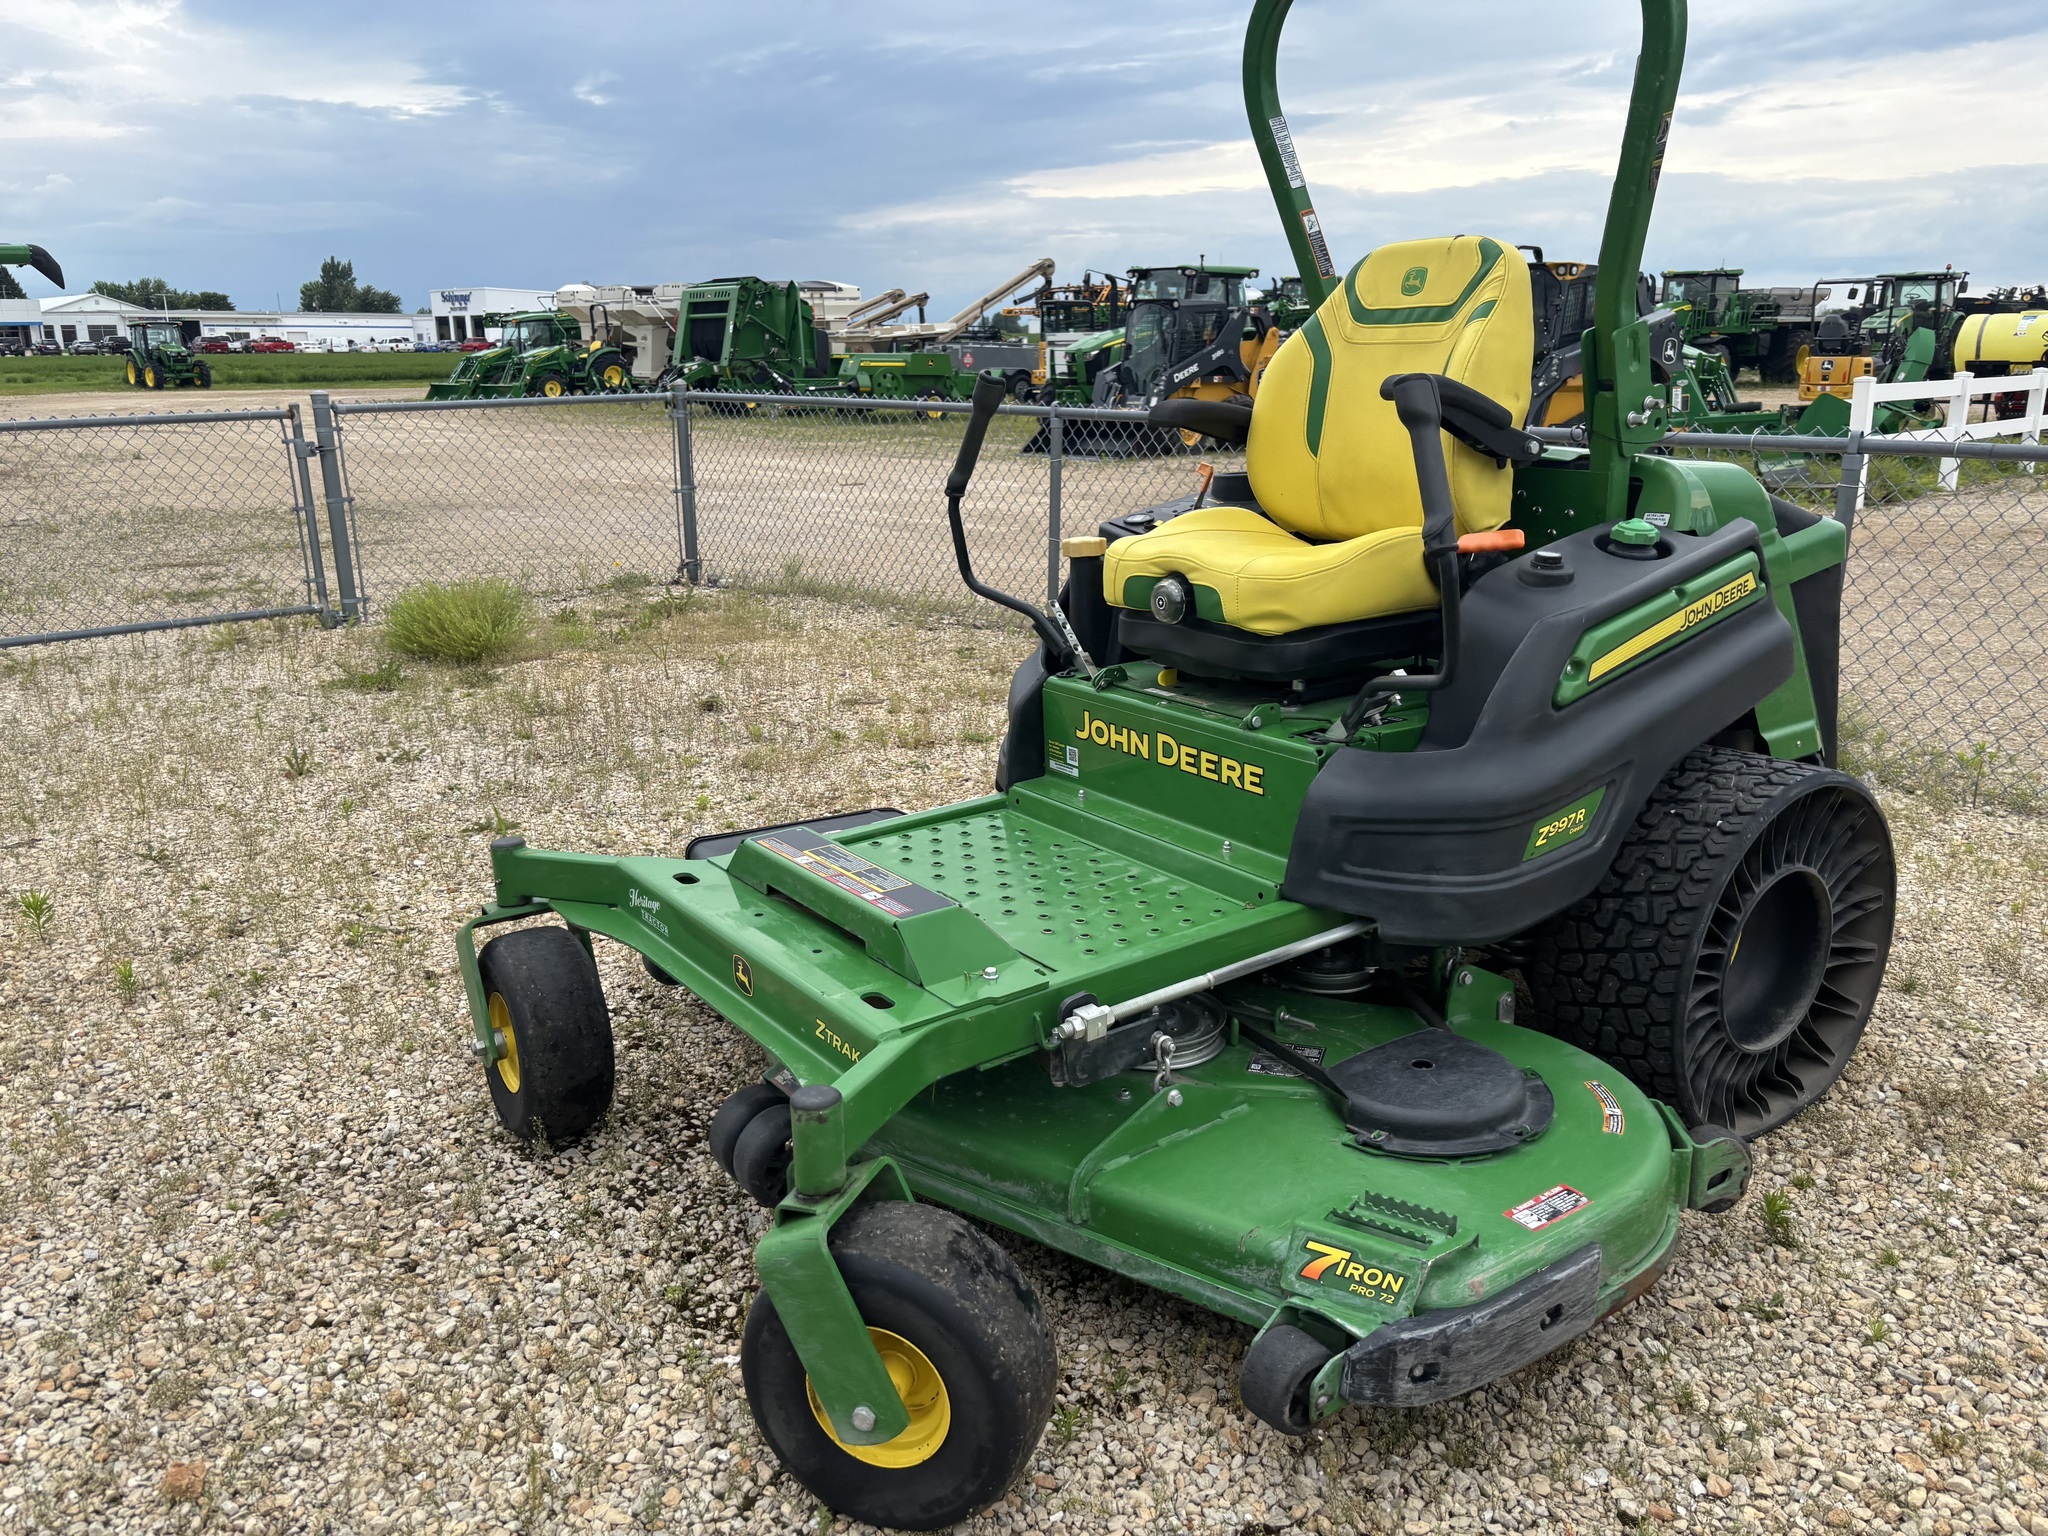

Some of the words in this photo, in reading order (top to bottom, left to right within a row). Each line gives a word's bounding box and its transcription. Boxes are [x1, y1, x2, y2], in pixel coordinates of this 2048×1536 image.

[1173, 362, 1200, 383] DEERE
[1680, 599, 1713, 629] JOHN
[1714, 579, 1750, 611] DEERE
[1075, 710, 1149, 760] JOHN
[1156, 730, 1265, 796] DEERE
[1535, 808, 1586, 847] Z997R
[629, 888, 661, 914] Heritage
[641, 909, 669, 934] TRACTOR
[1349, 1283, 1376, 1298] PRO
[1379, 1292, 1395, 1304] 72
